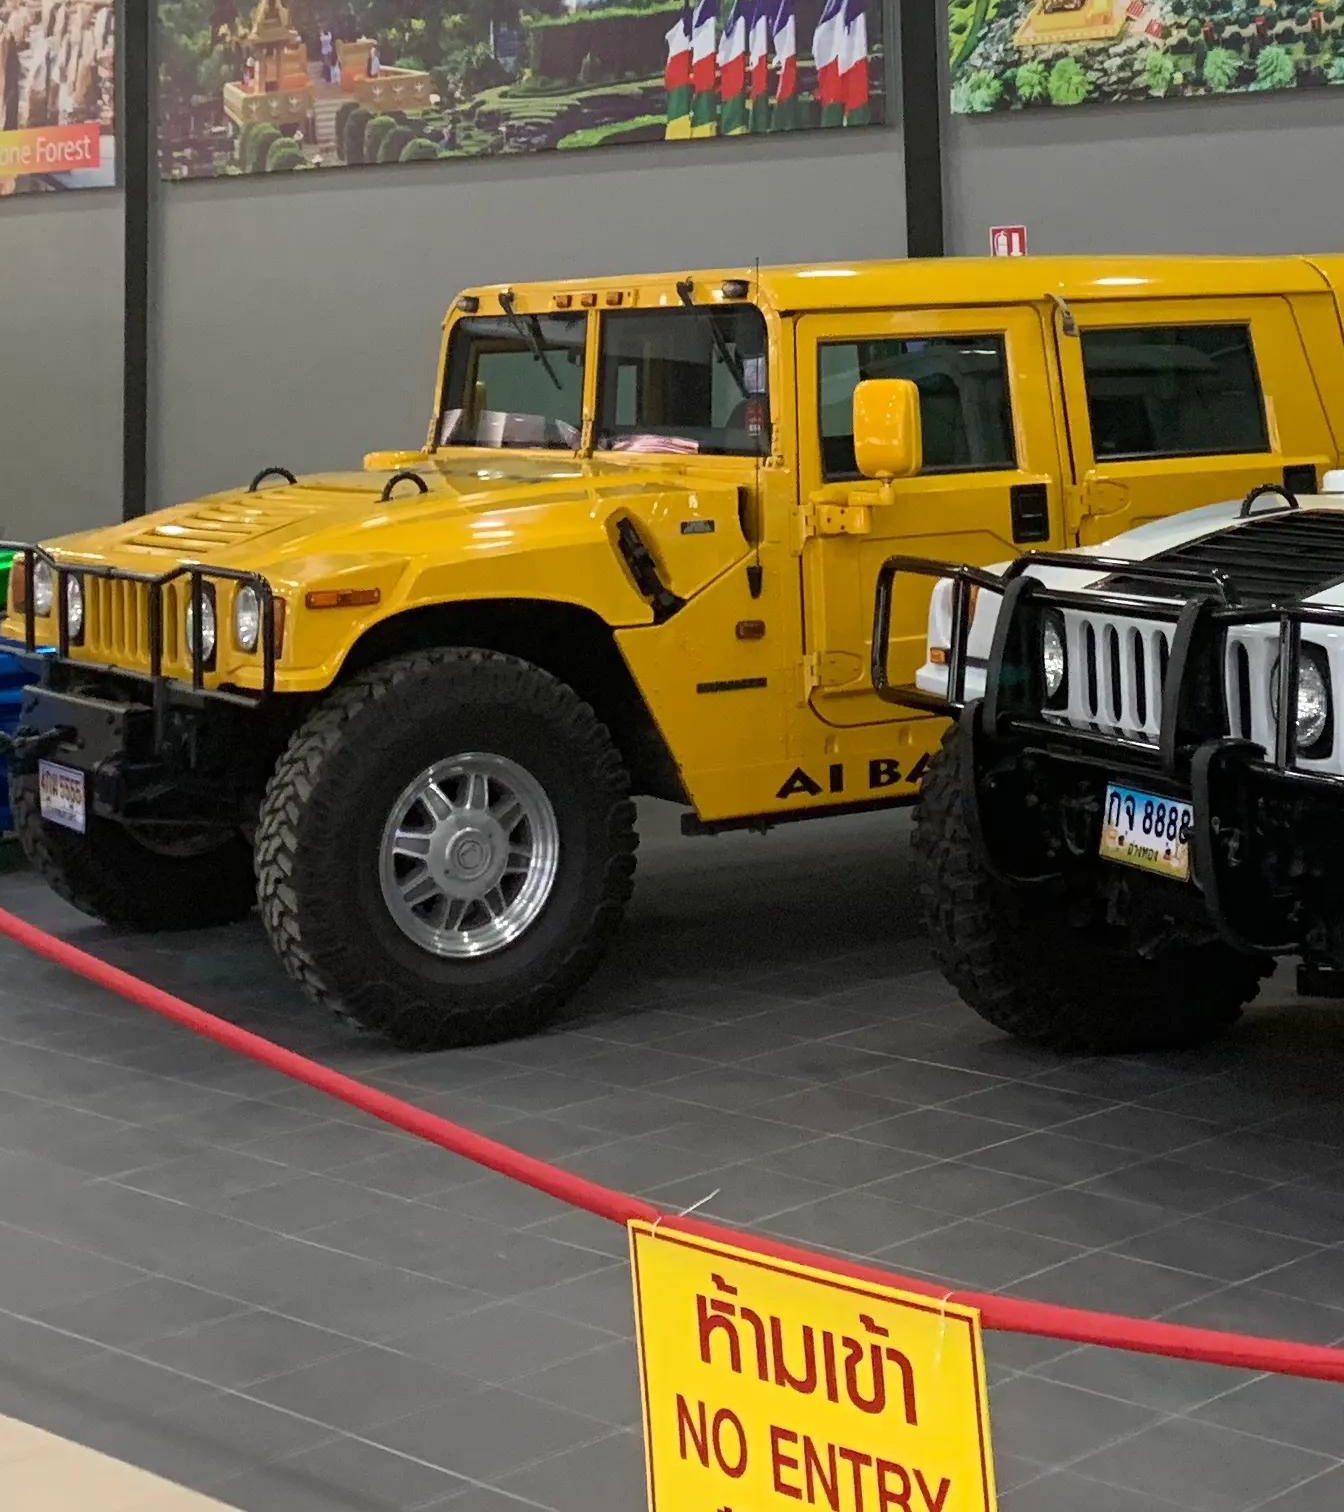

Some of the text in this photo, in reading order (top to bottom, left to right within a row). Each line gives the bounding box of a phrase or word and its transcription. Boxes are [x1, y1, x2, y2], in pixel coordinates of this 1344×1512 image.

[36, 136, 92, 164] Forest
[775, 751, 931, 799] AI BA
[695, 1273, 919, 1427] ห้ามเข้า
[675, 1392, 951, 1512] NO ENTRY
